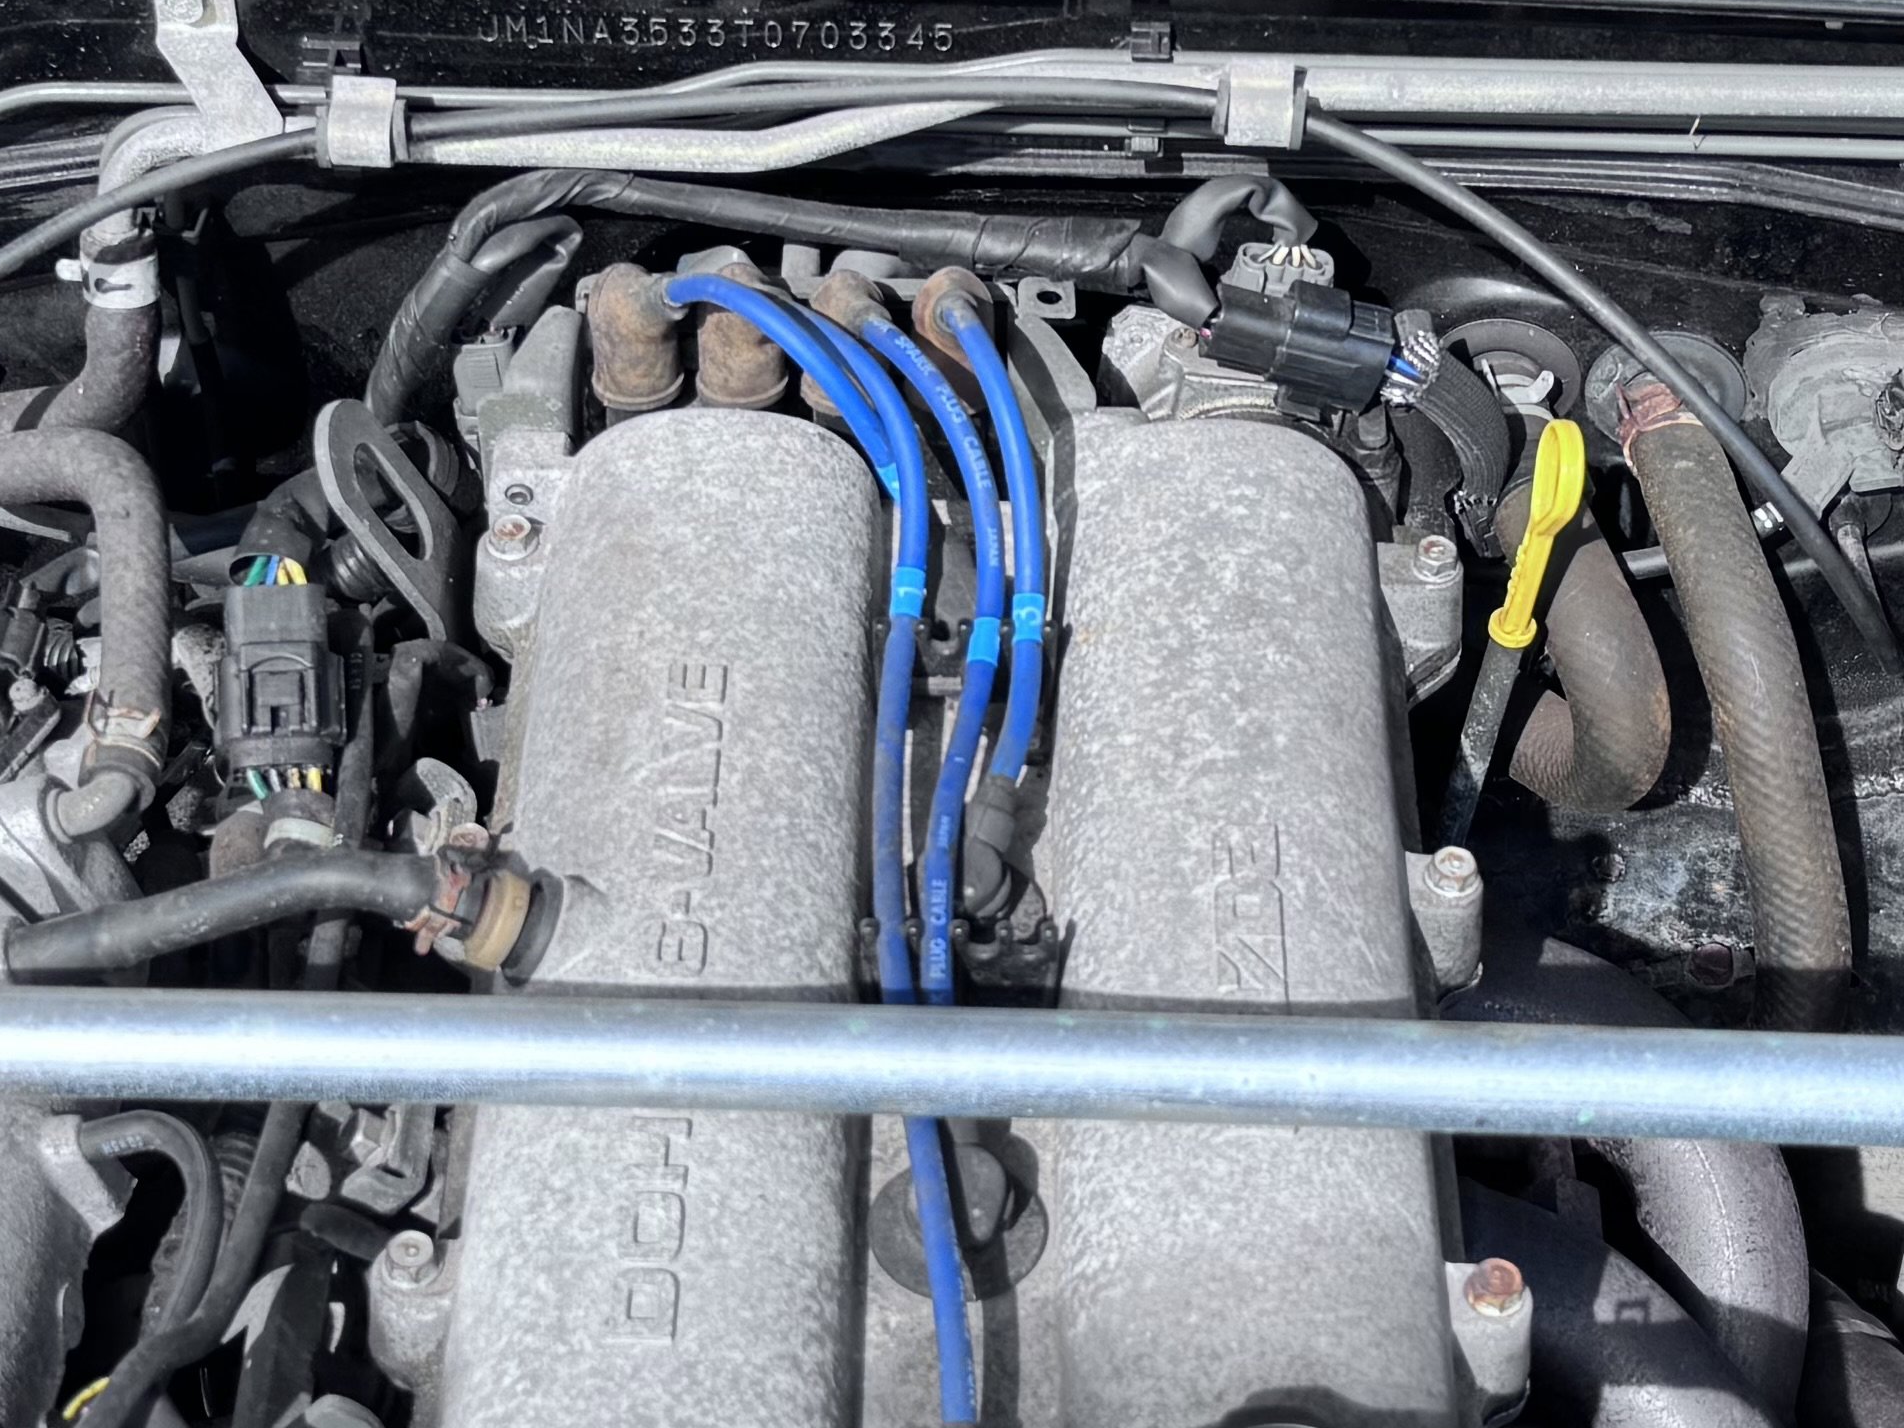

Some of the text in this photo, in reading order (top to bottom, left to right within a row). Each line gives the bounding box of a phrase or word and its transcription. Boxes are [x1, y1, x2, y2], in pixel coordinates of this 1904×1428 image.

[479, 15, 954, 50] JM1NA3533T0703345
[892, 334, 933, 380] SPARK
[936, 381, 965, 427] PLUG
[959, 432, 993, 491] CABLE
[1012, 605, 1041, 625] 3
[610, 661, 728, 1343] DOH 6-VALVE
